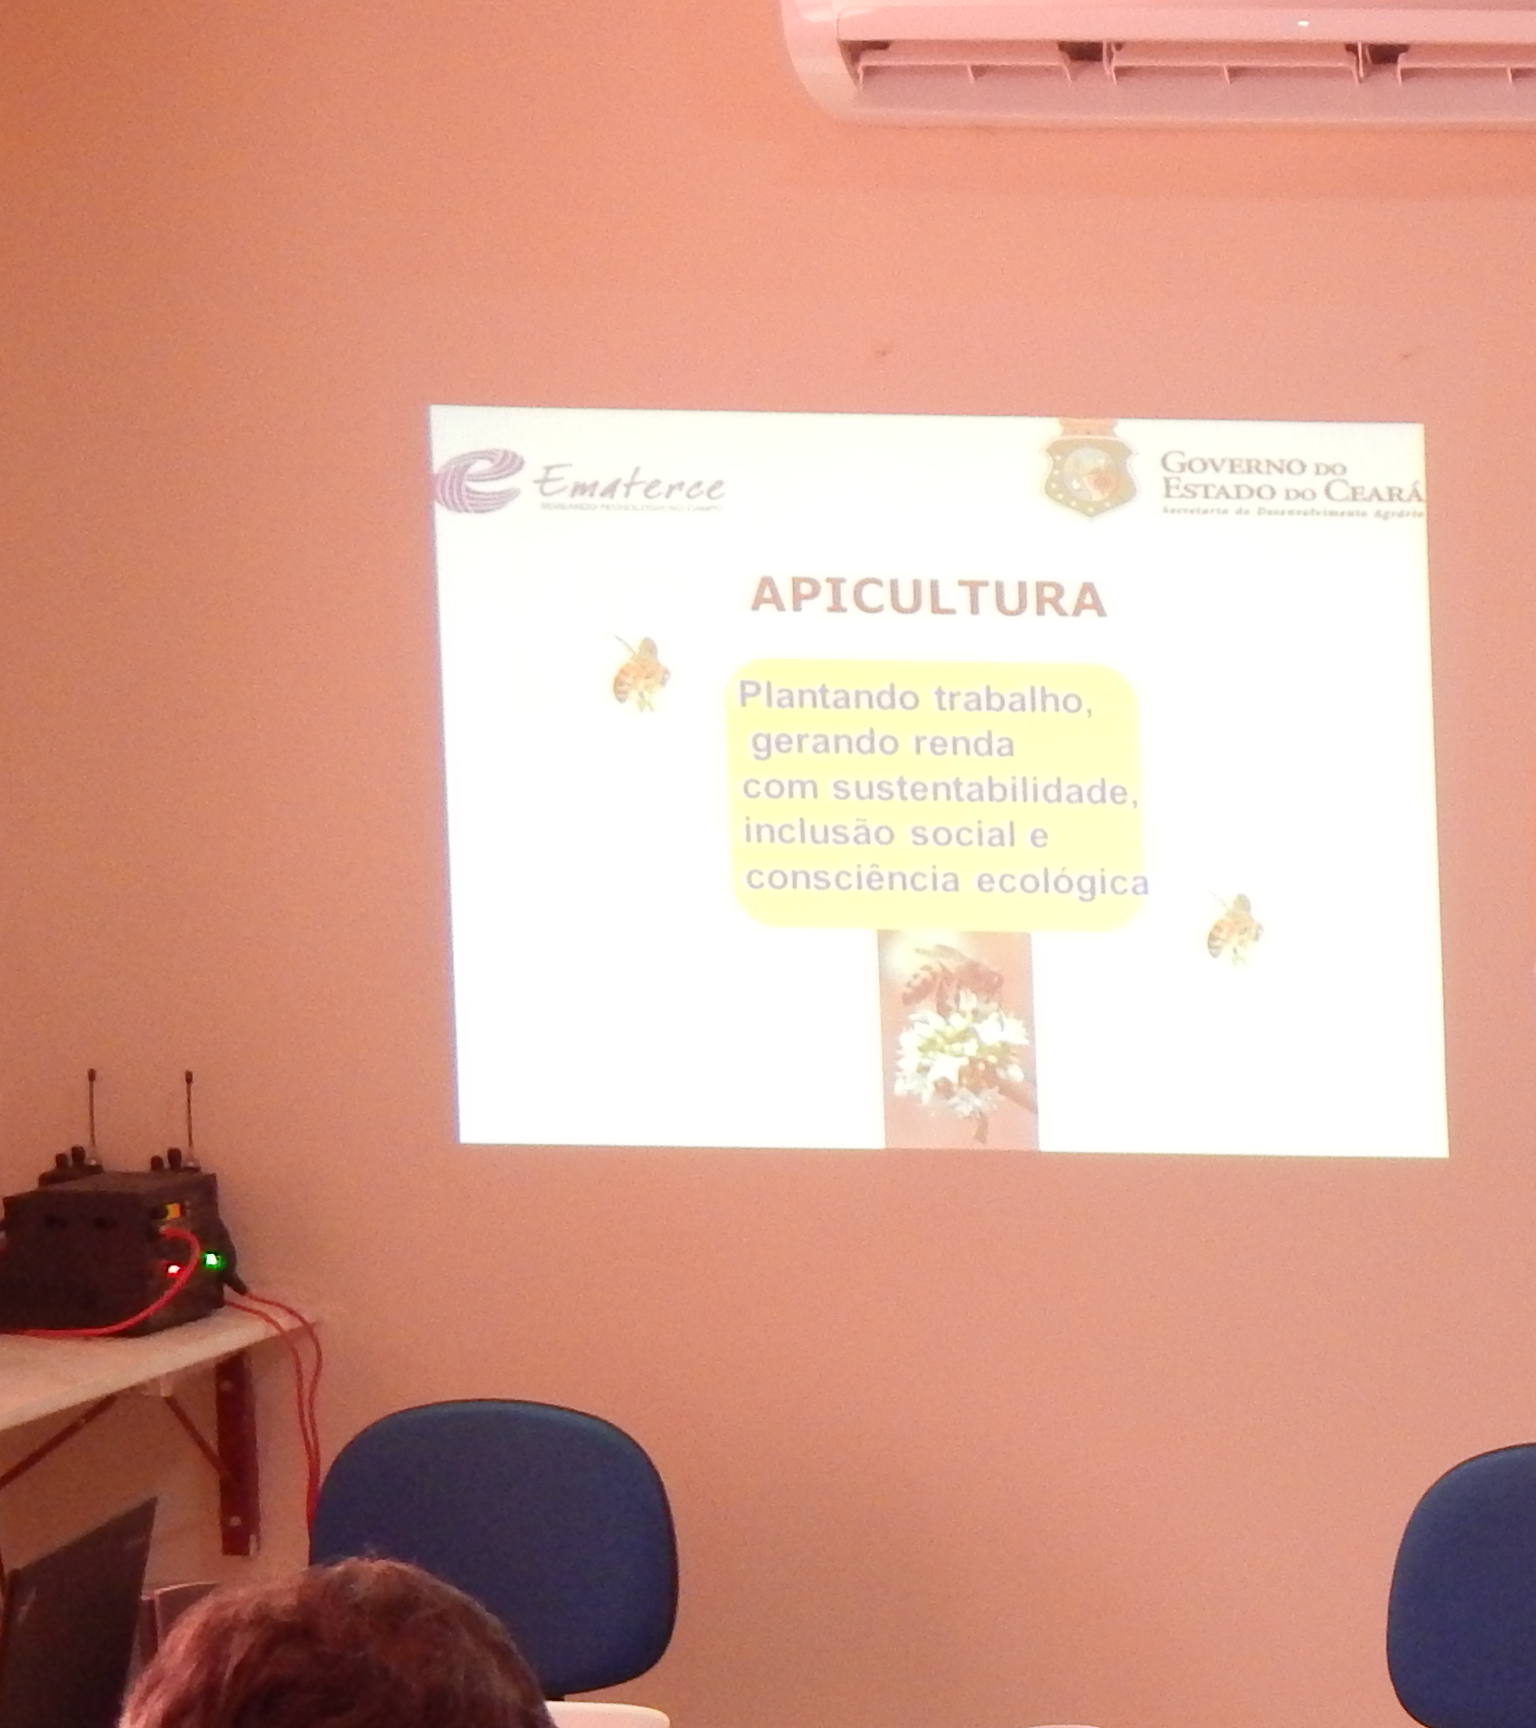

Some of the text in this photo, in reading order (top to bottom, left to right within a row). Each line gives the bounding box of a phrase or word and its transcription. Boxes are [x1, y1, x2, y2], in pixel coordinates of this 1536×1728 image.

[533, 464, 727, 500] Ematerce
[751, 575, 1107, 618] APICULTURA
[739, 679, 1093, 718] Plantando trabalho,
[752, 728, 1015, 761] gerando renda
[743, 775, 1138, 809] com sustentabilidade,
[745, 816, 1049, 848] inclusão social e
[746, 864, 1149, 902] consciência ecológica
